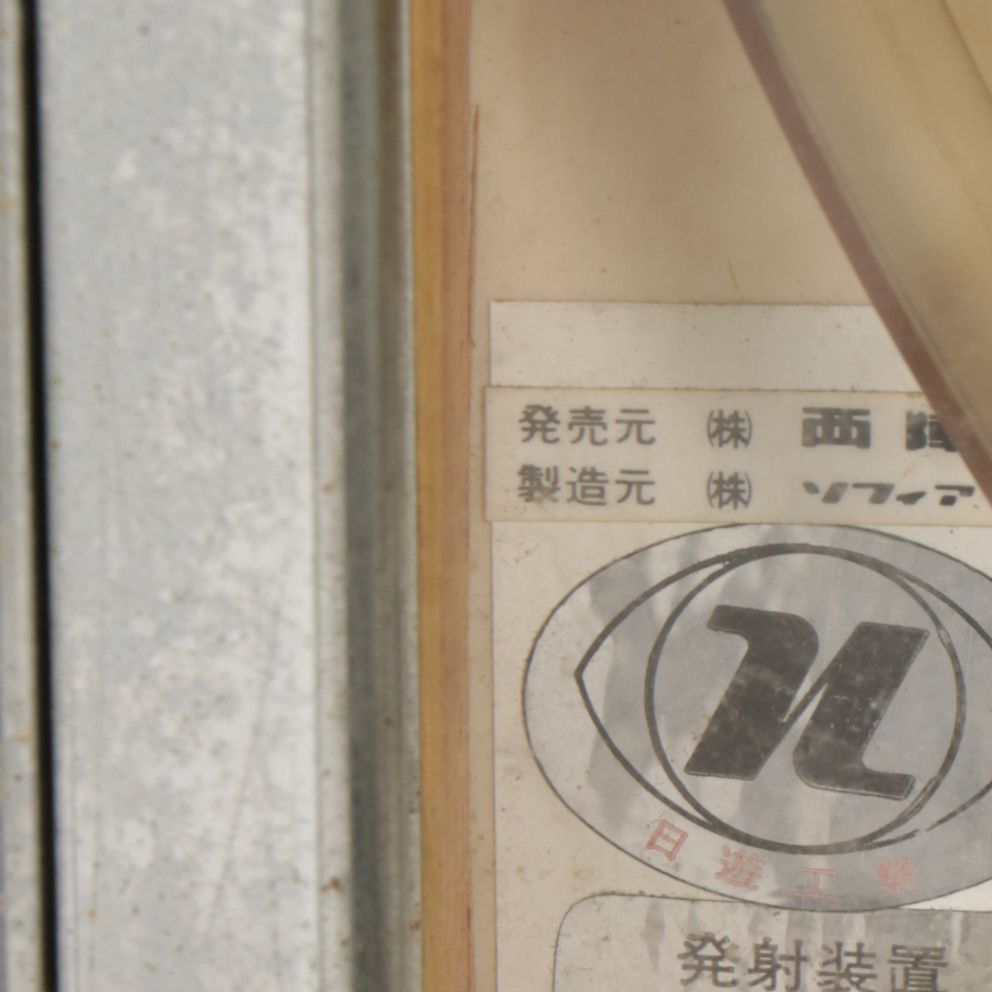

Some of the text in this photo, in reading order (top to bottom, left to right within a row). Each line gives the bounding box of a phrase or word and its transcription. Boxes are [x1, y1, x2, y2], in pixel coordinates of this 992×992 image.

[518, 403, 656, 446] 発売元
[518, 464, 656, 506] 製造元
[802, 481, 976, 507] ソフィア
